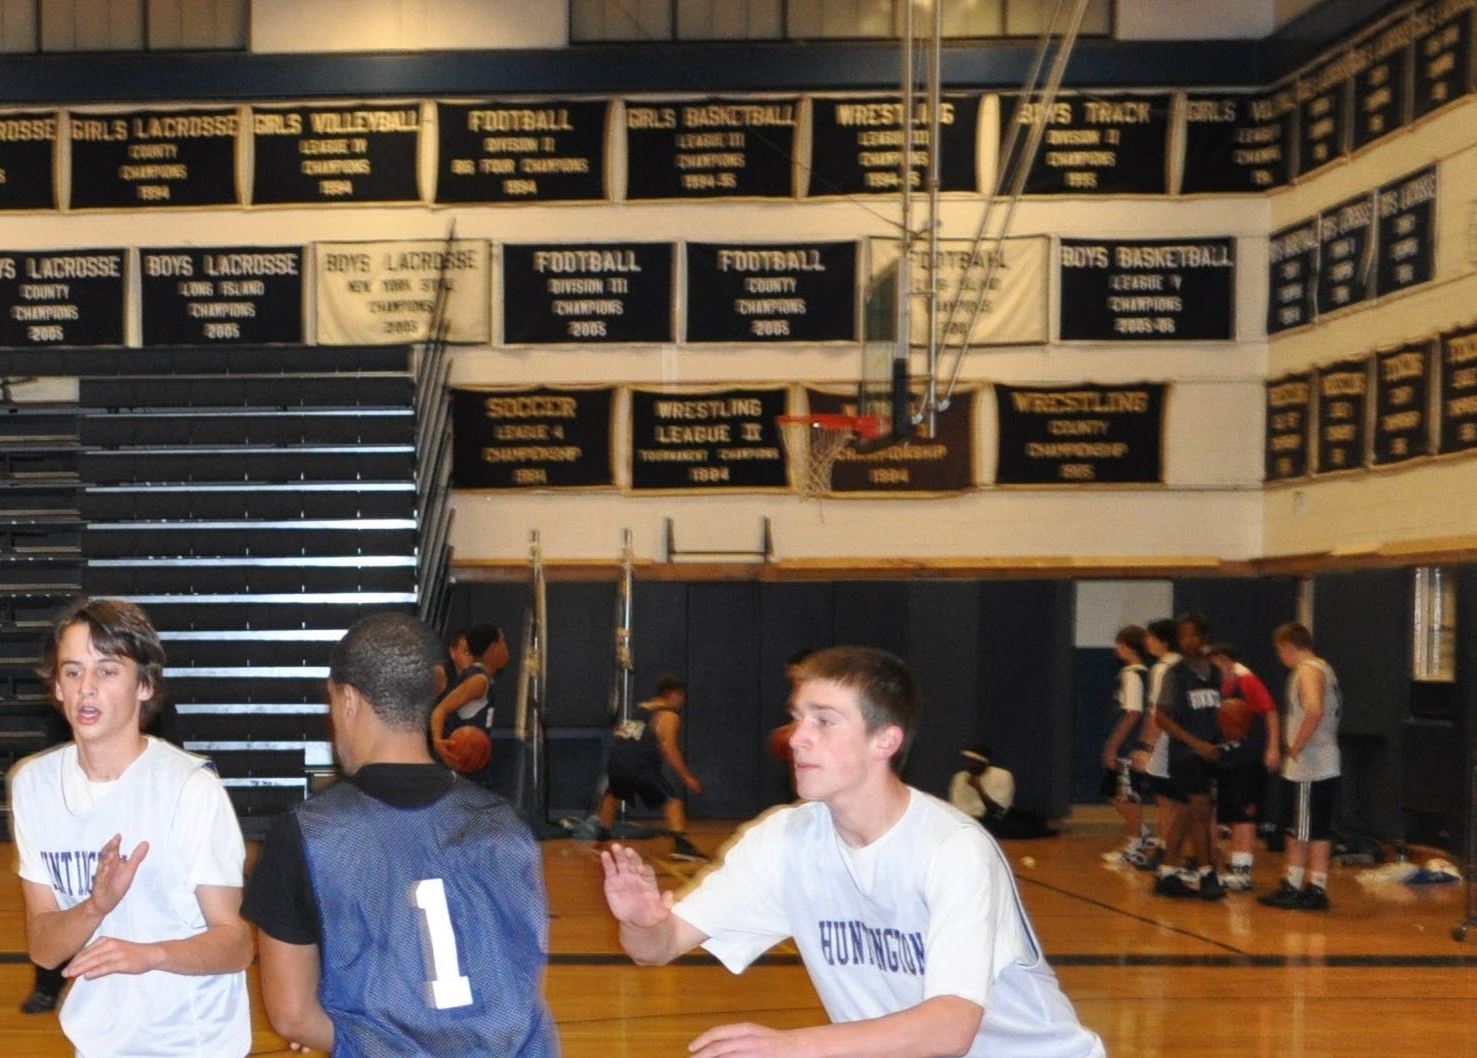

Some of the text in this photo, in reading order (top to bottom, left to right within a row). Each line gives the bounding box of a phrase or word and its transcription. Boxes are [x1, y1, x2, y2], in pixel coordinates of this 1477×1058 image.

[468, 110, 573, 131] FOOTBALL
[627, 105, 796, 129] GIRLS BASKETBALL
[1084, 102, 1151, 123] TRACK
[72, 115, 238, 141] GIRLS LACROSSE
[254, 110, 420, 134] GIRLS VOLLEYBALL
[127, 144, 177, 159] COUNTY
[676, 153, 745, 168] CHAMPIONS
[119, 164, 187, 180] CHAMPIONS
[145, 254, 298, 277] BOYS LACROSSE
[325, 250, 477, 272] BOYS LACROSSE
[533, 251, 642, 273] FOOTBALL
[718, 250, 825, 272] FOOTBALL
[1062, 246, 1233, 269] BOYS BASKETBALL
[26, 256, 121, 279] LACROSSE
[179, 280, 264, 297] LONG ISLAND
[547, 279, 603, 294] DIVISION
[744, 277, 796, 293] COUNTY
[1110, 275, 1163, 290] LEAGUE
[20, 285, 70, 300] COUNTY
[11, 305, 79, 320] CHAMPIONS
[188, 301, 255, 318] CHAMPIONS
[552, 300, 623, 316] CHAMPIONS
[735, 299, 806, 315] CHAMPIONS
[1109, 297, 1182, 312] CHAMPIONS
[28, 326, 63, 341] 2005
[204, 324, 240, 339] 2005
[568, 321, 606, 336] 2005
[750, 320, 789, 336] 2005
[486, 397, 577, 419] SOCCER
[654, 399, 762, 420] WRESTLING
[1010, 391, 1149, 413] WRESTLING
[654, 425, 730, 443] LEAGUE
[1048, 421, 1109, 435] COUNTY
[638, 448, 780, 462] TOURNAMENT CHAMPIONS
[412, 878, 473, 1010] 1
